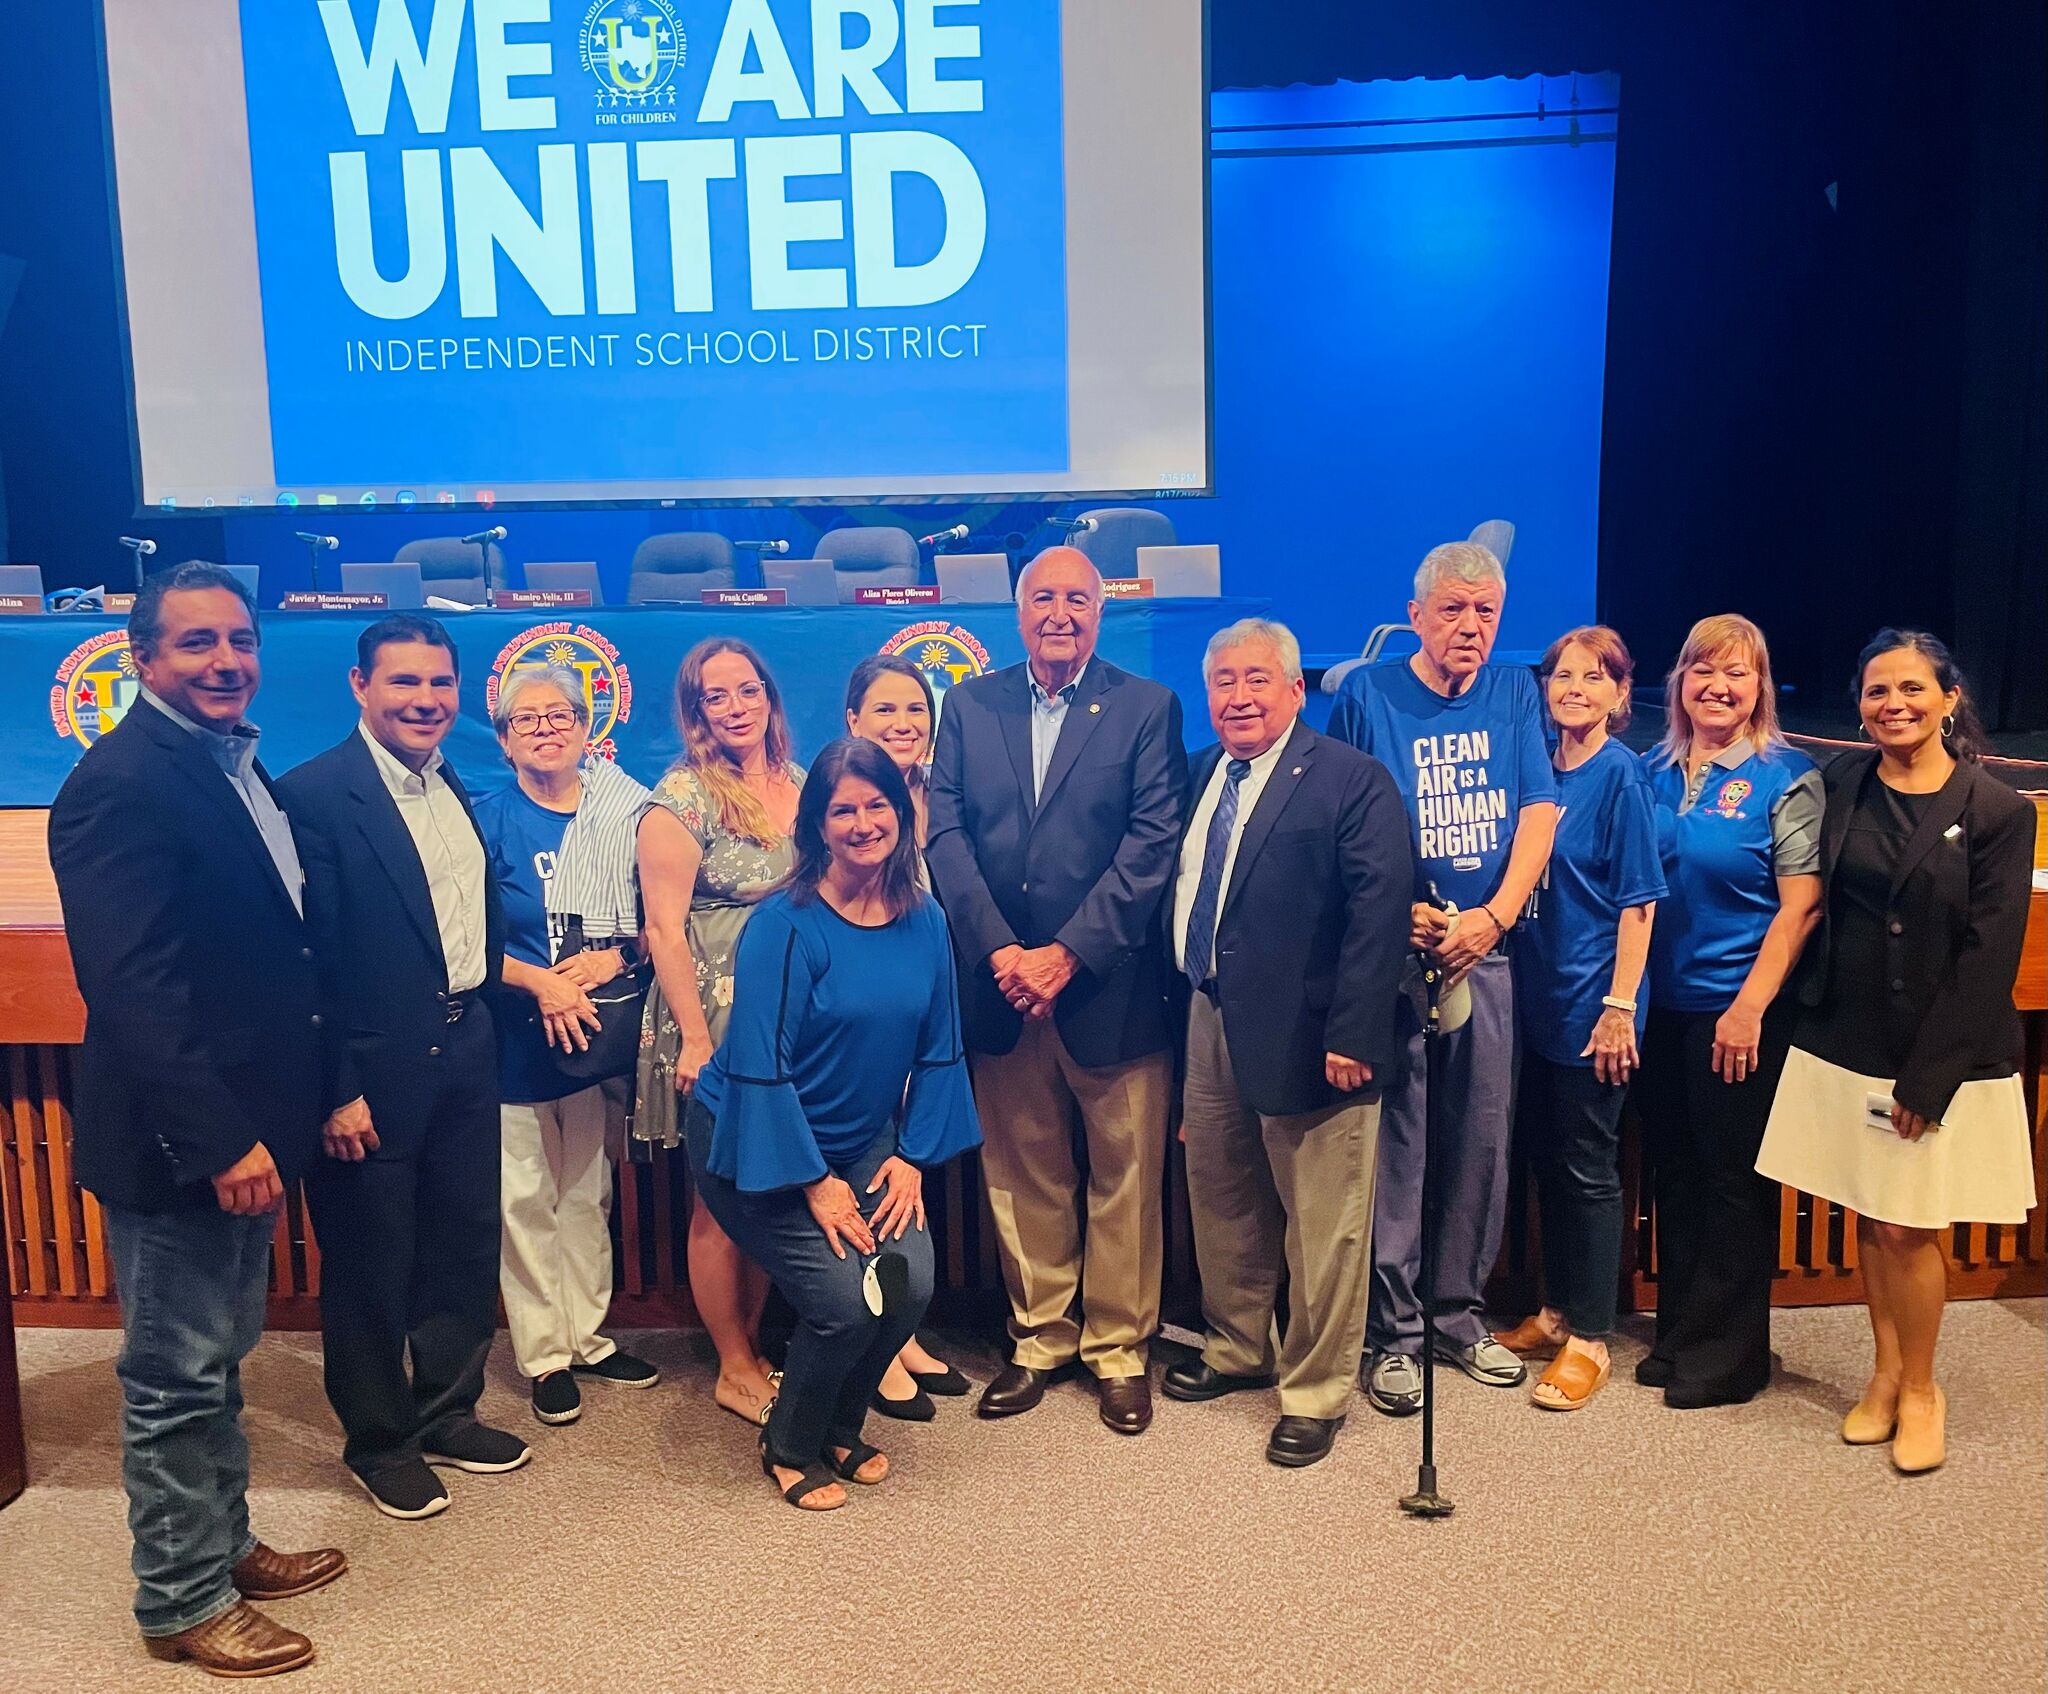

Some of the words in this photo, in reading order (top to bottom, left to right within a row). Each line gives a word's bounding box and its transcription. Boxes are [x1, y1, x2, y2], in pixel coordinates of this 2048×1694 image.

[318, 0, 558, 136] WE
[696, 0, 985, 124] ARE
[579, 28, 591, 72] UNITED
[595, 113, 618, 126] FOR
[620, 112, 677, 125] CHILDREN
[329, 131, 987, 320] UNITED
[346, 334, 620, 372] INDEPENDENT
[635, 329, 799, 366] SCHOOL
[814, 324, 988, 361] DISTRICT
[111, 597, 131, 606] Juan
[289, 594, 317, 603] Javier
[372, 595, 384, 604] Jr.
[512, 593, 541, 601] Ramiro
[564, 593, 574, 601] III
[720, 594, 741, 602] Frank
[742, 593, 768, 602] Castillo
[55, 629, 129, 683] INDEPENDE
[492, 622, 572, 673] INDEPENDENT
[574, 624, 621, 663] SCHOOL
[878, 620, 950, 657] DEPENDENT
[949, 626, 991, 669] SCHOOL
[51, 685, 72, 738] UNITED
[486, 675, 499, 718] NITED
[615, 663, 632, 724] DISTRICT
[1413, 730, 1490, 768] CLEAN
[1416, 764, 1458, 798] AIR
[1460, 768, 1475, 788] IS
[1477, 767, 1488, 787] A
[1418, 788, 1507, 829] HUMAN
[1420, 820, 1498, 860] RIGHT!
